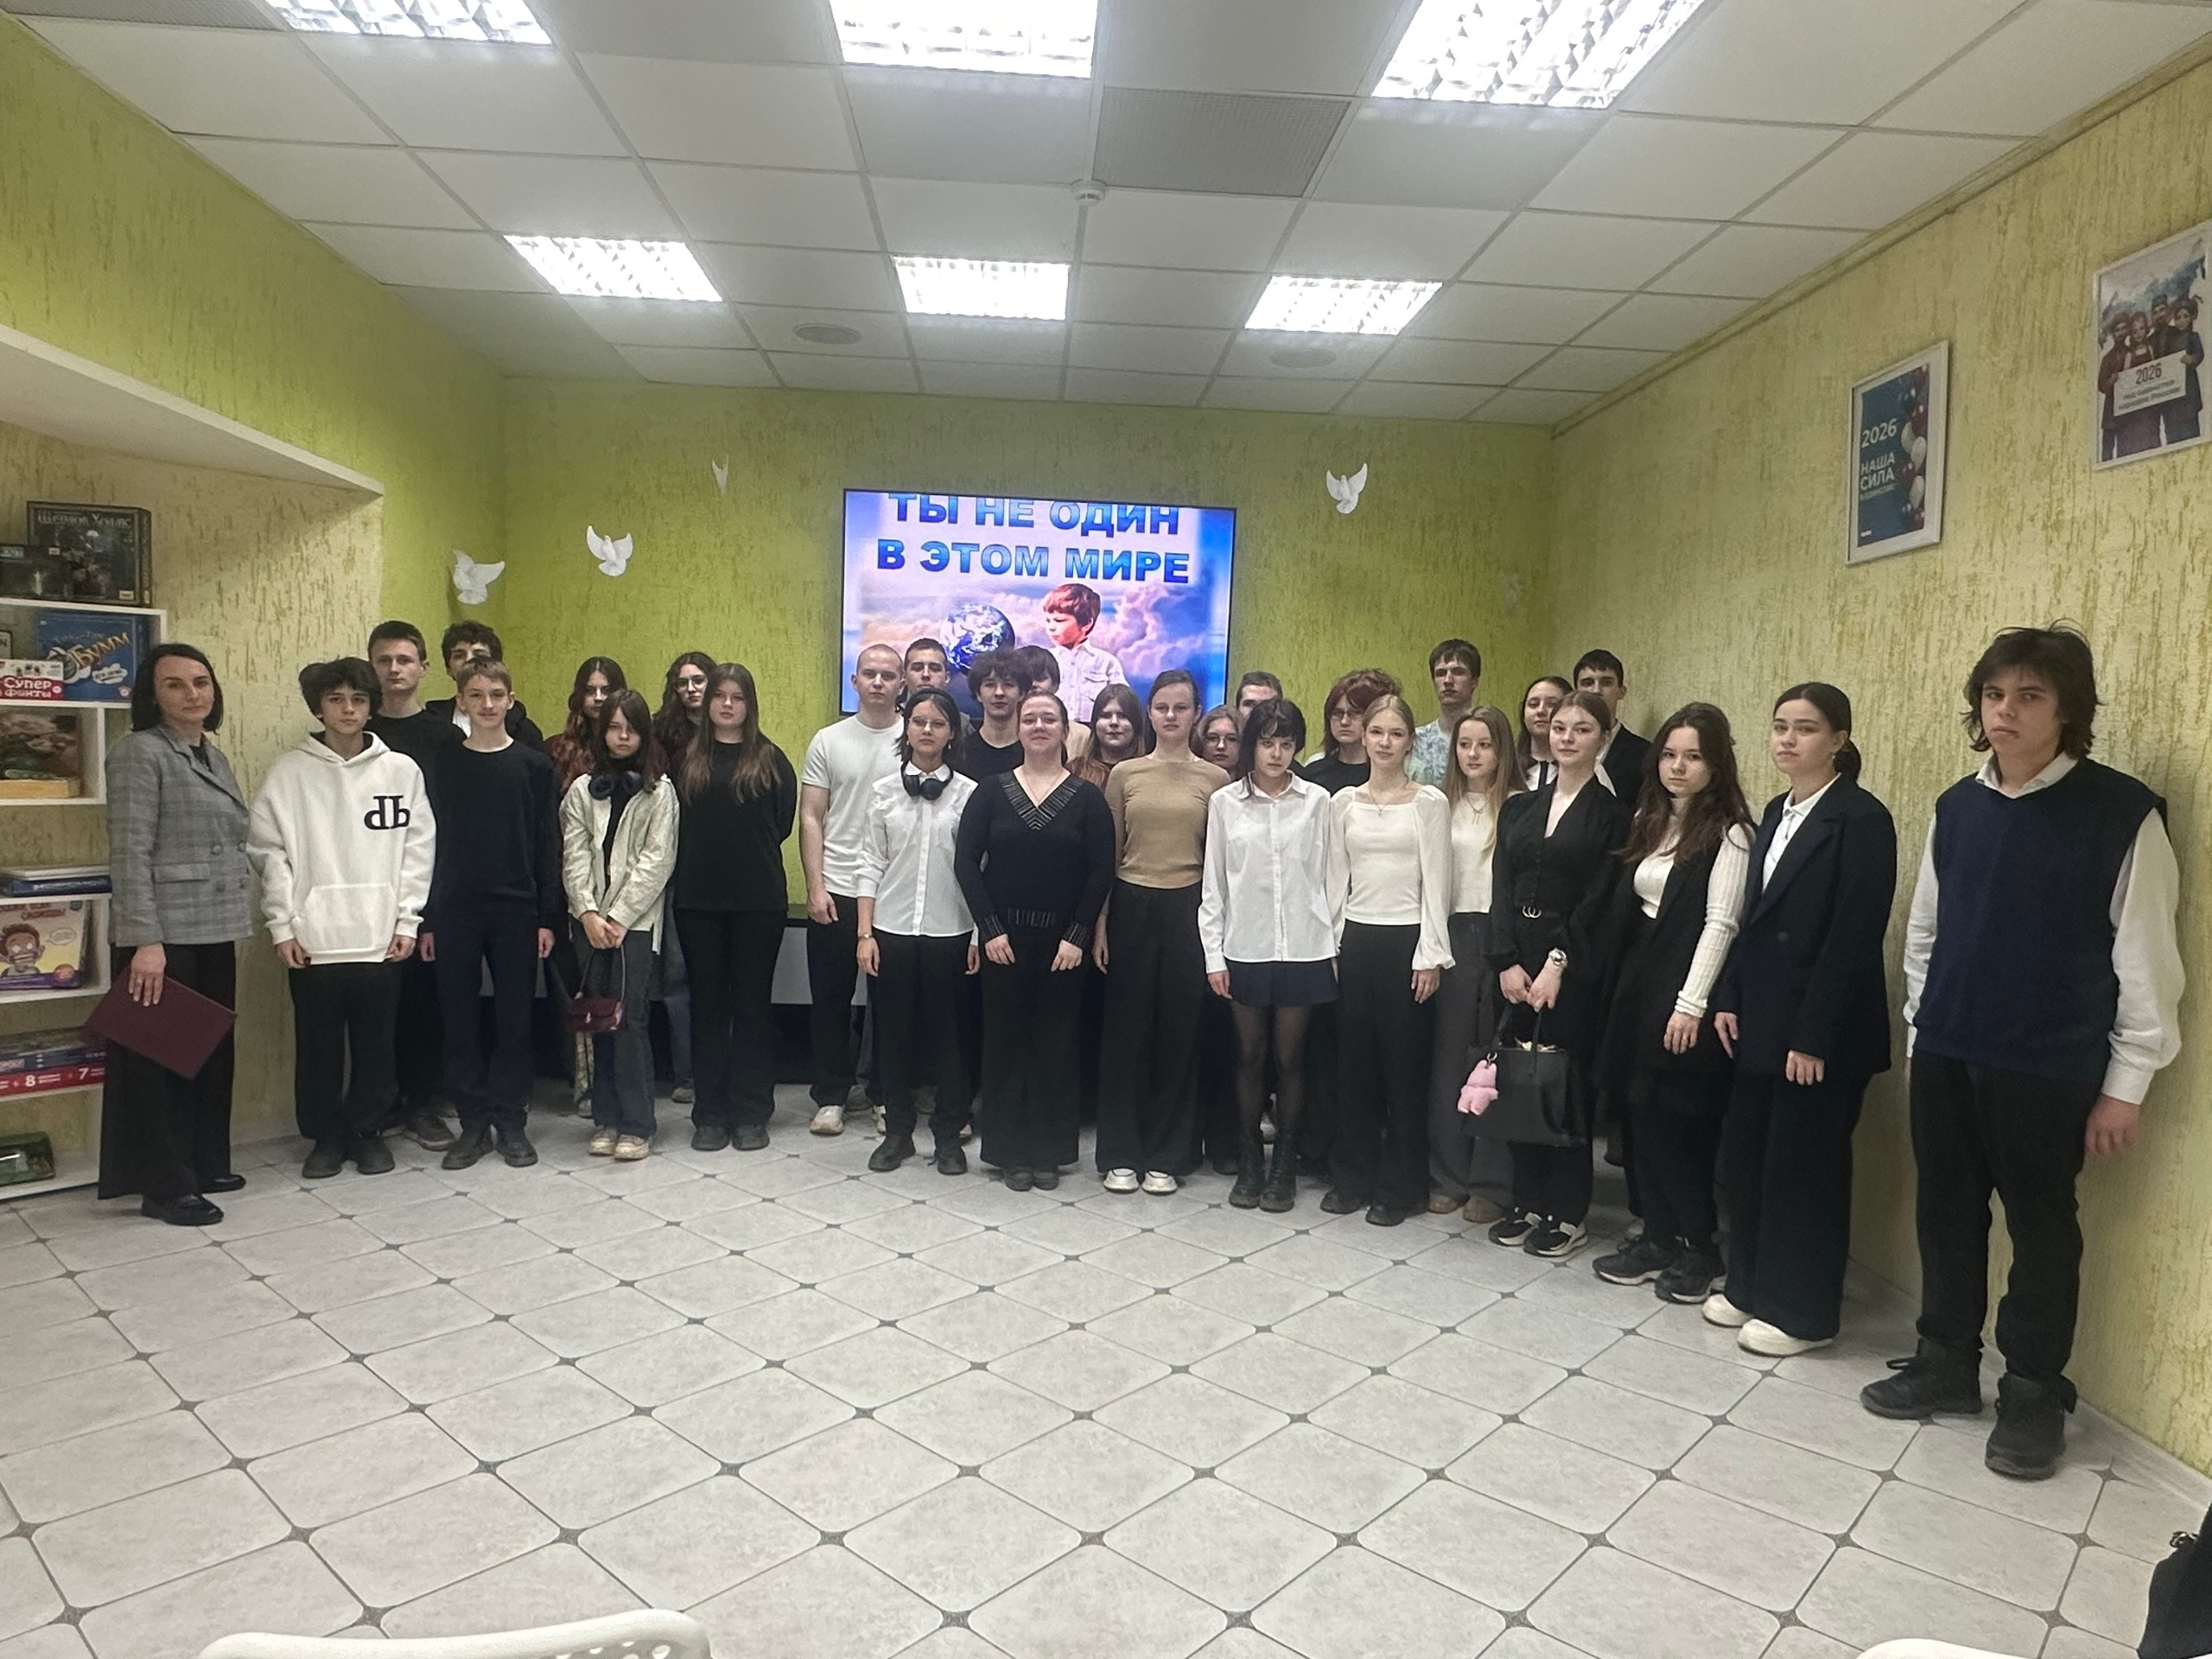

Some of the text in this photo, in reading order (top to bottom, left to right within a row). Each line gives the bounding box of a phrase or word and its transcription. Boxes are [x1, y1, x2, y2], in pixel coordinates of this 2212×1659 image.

[2136, 363, 2162, 385] 2026
[1861, 418, 1897, 448] 2026
[1861, 452, 1895, 474] НАША
[1859, 467, 1895, 490] СИЛА
[888, 493, 1179, 538] ТЫ НЕ ОДИН
[877, 538, 1190, 584] В ЭТОМ МИРЕ
[3, 677, 52, 690] Супер
